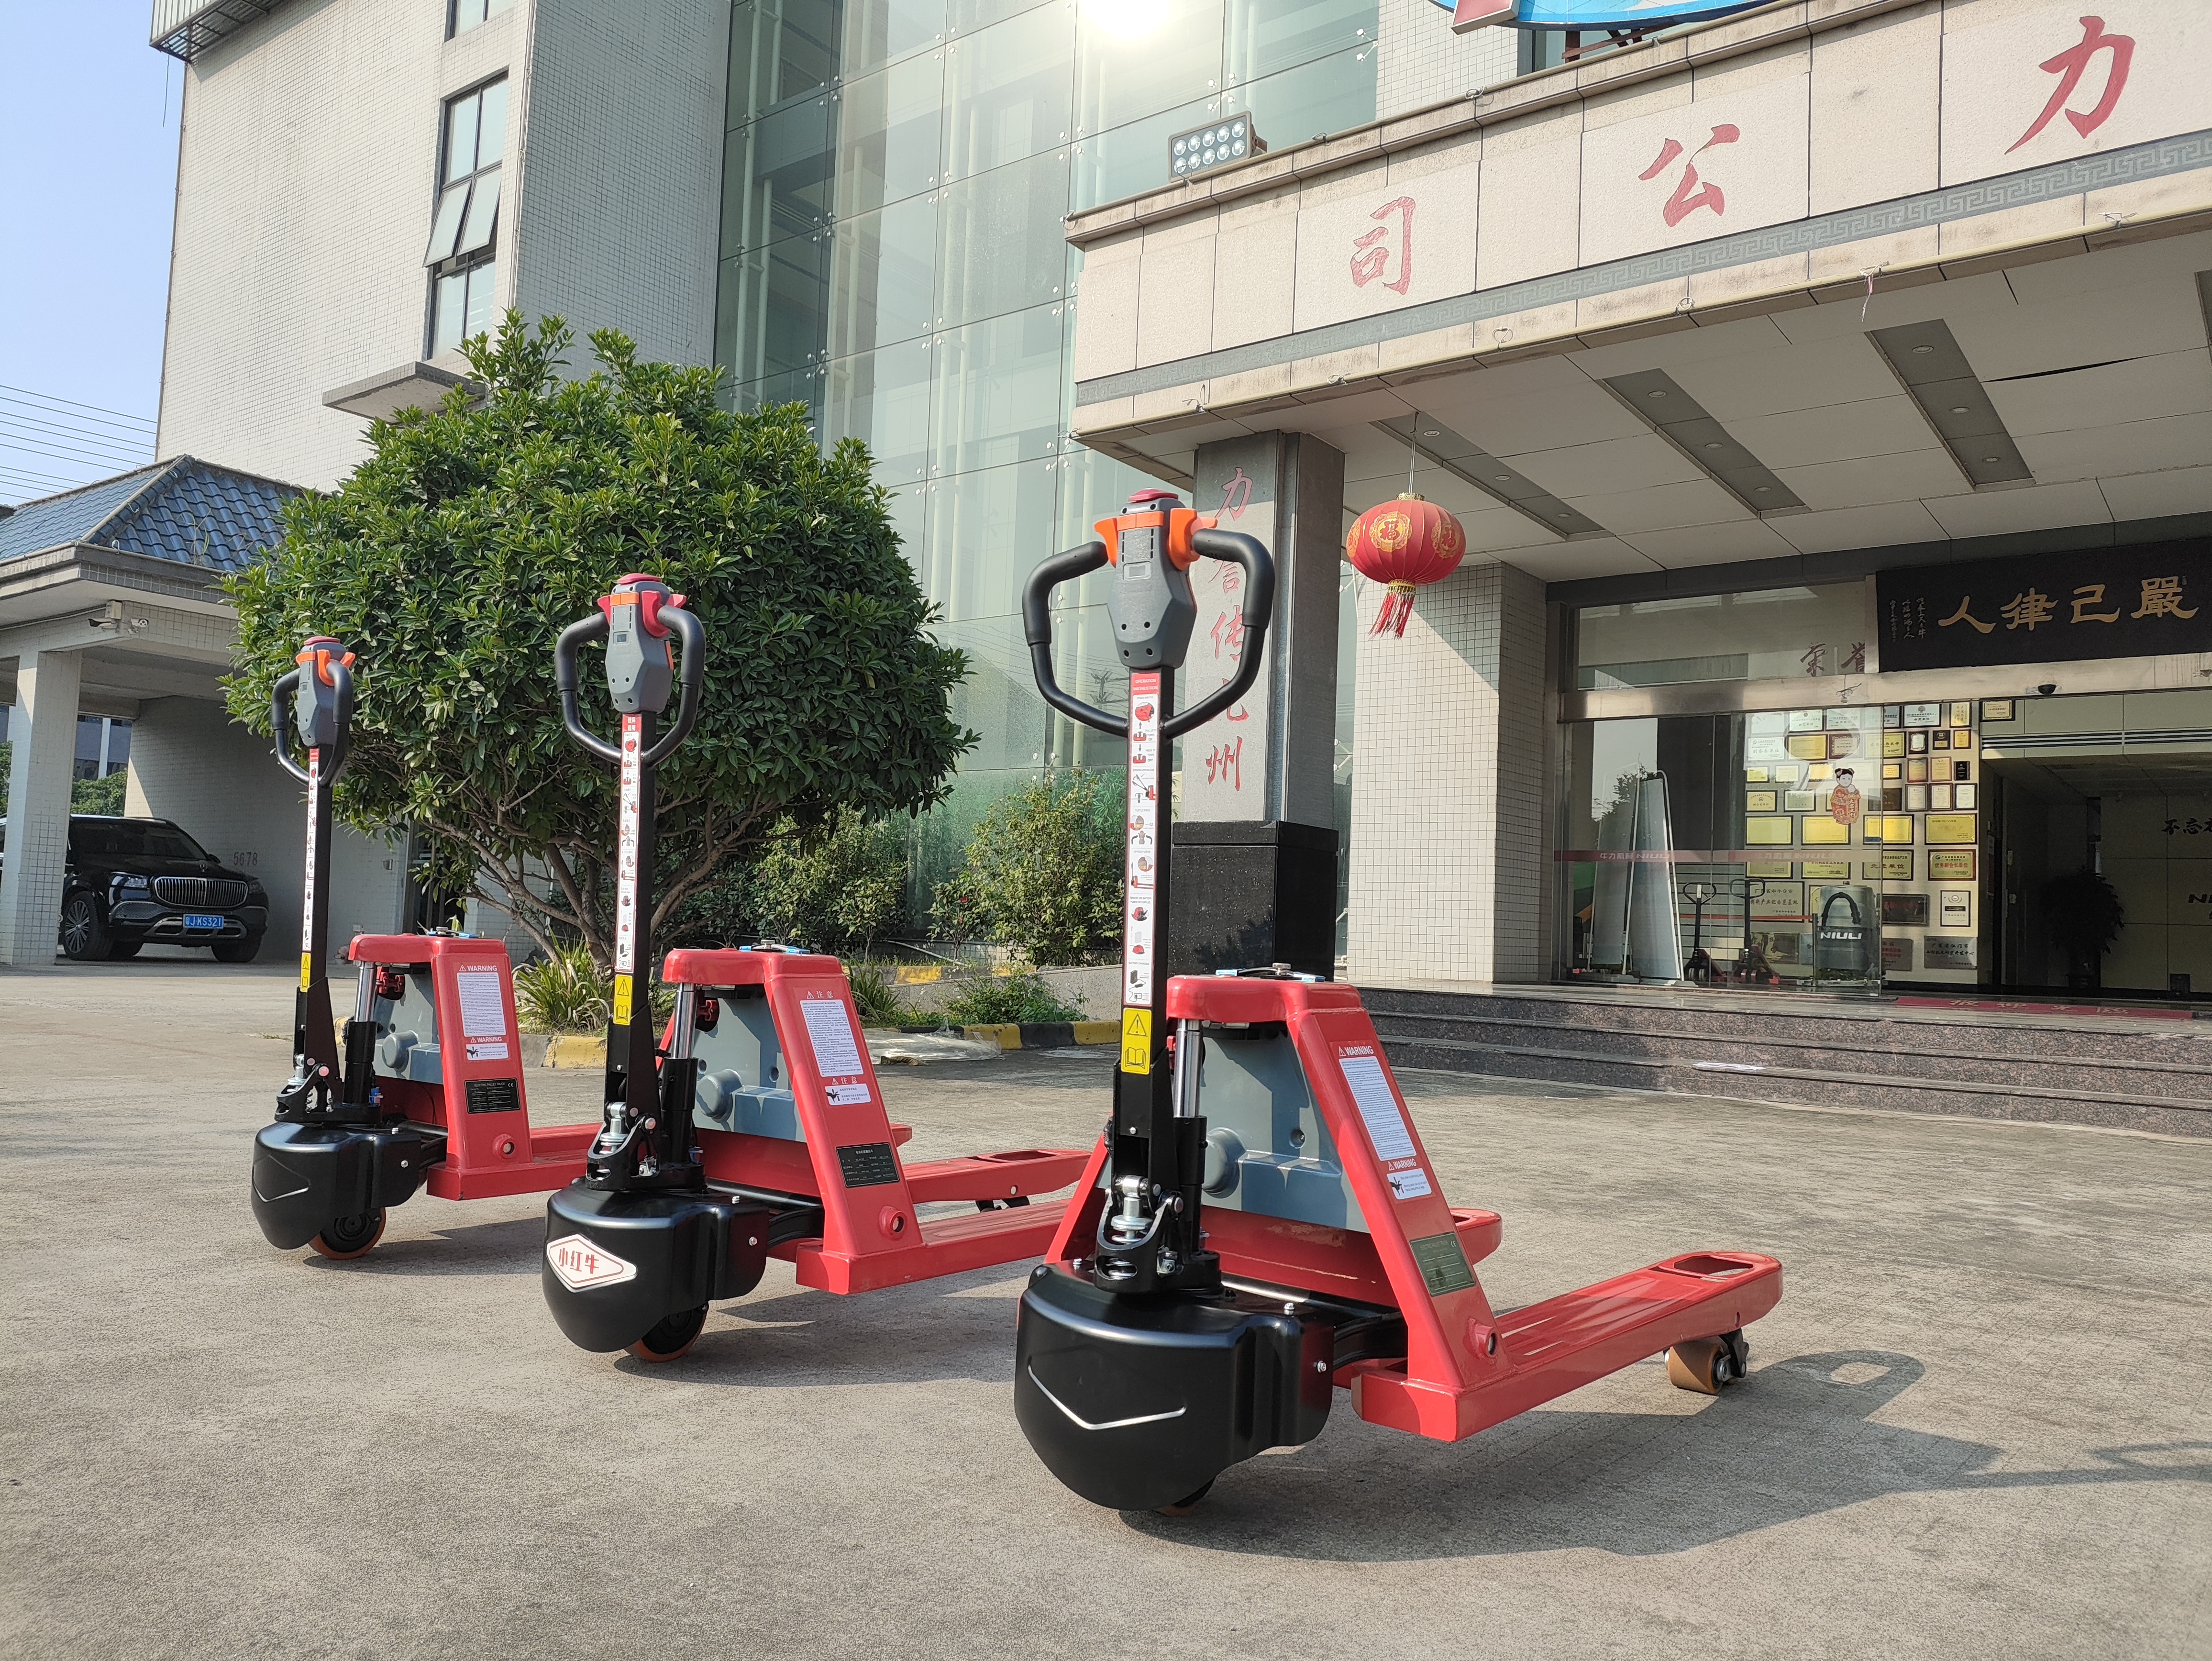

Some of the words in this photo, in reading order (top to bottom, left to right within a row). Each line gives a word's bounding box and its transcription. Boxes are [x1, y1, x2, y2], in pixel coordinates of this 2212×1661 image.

[1380, 520, 1400, 541] 福
[233, 852, 258, 866] 5678
[1344, 1045, 1374, 1056] WARNING
[1393, 1158, 1416, 1169] WARNING
[559, 1248, 599, 1274] 小红牛
